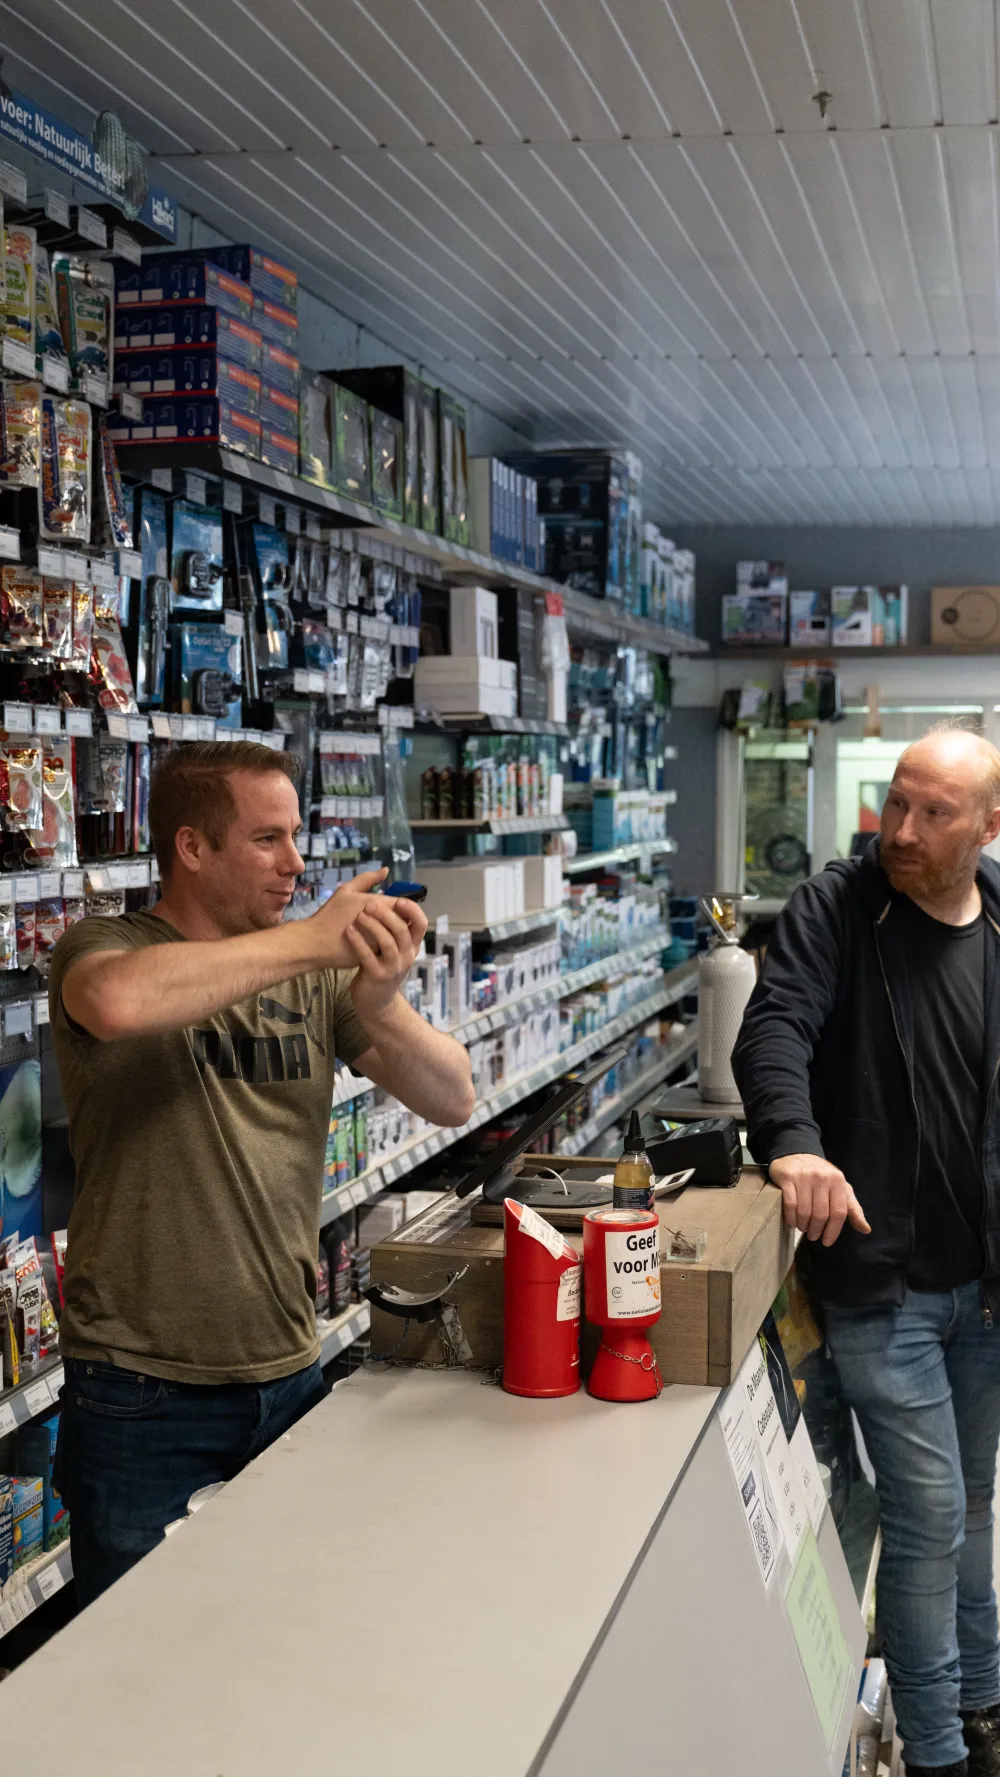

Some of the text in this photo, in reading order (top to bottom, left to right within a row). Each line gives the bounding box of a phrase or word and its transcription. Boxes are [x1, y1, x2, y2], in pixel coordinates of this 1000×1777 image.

[35, 113, 92, 169] Natuurlijk
[626, 1229, 656, 1252] Geef
[613, 1258, 649, 1274] voor
